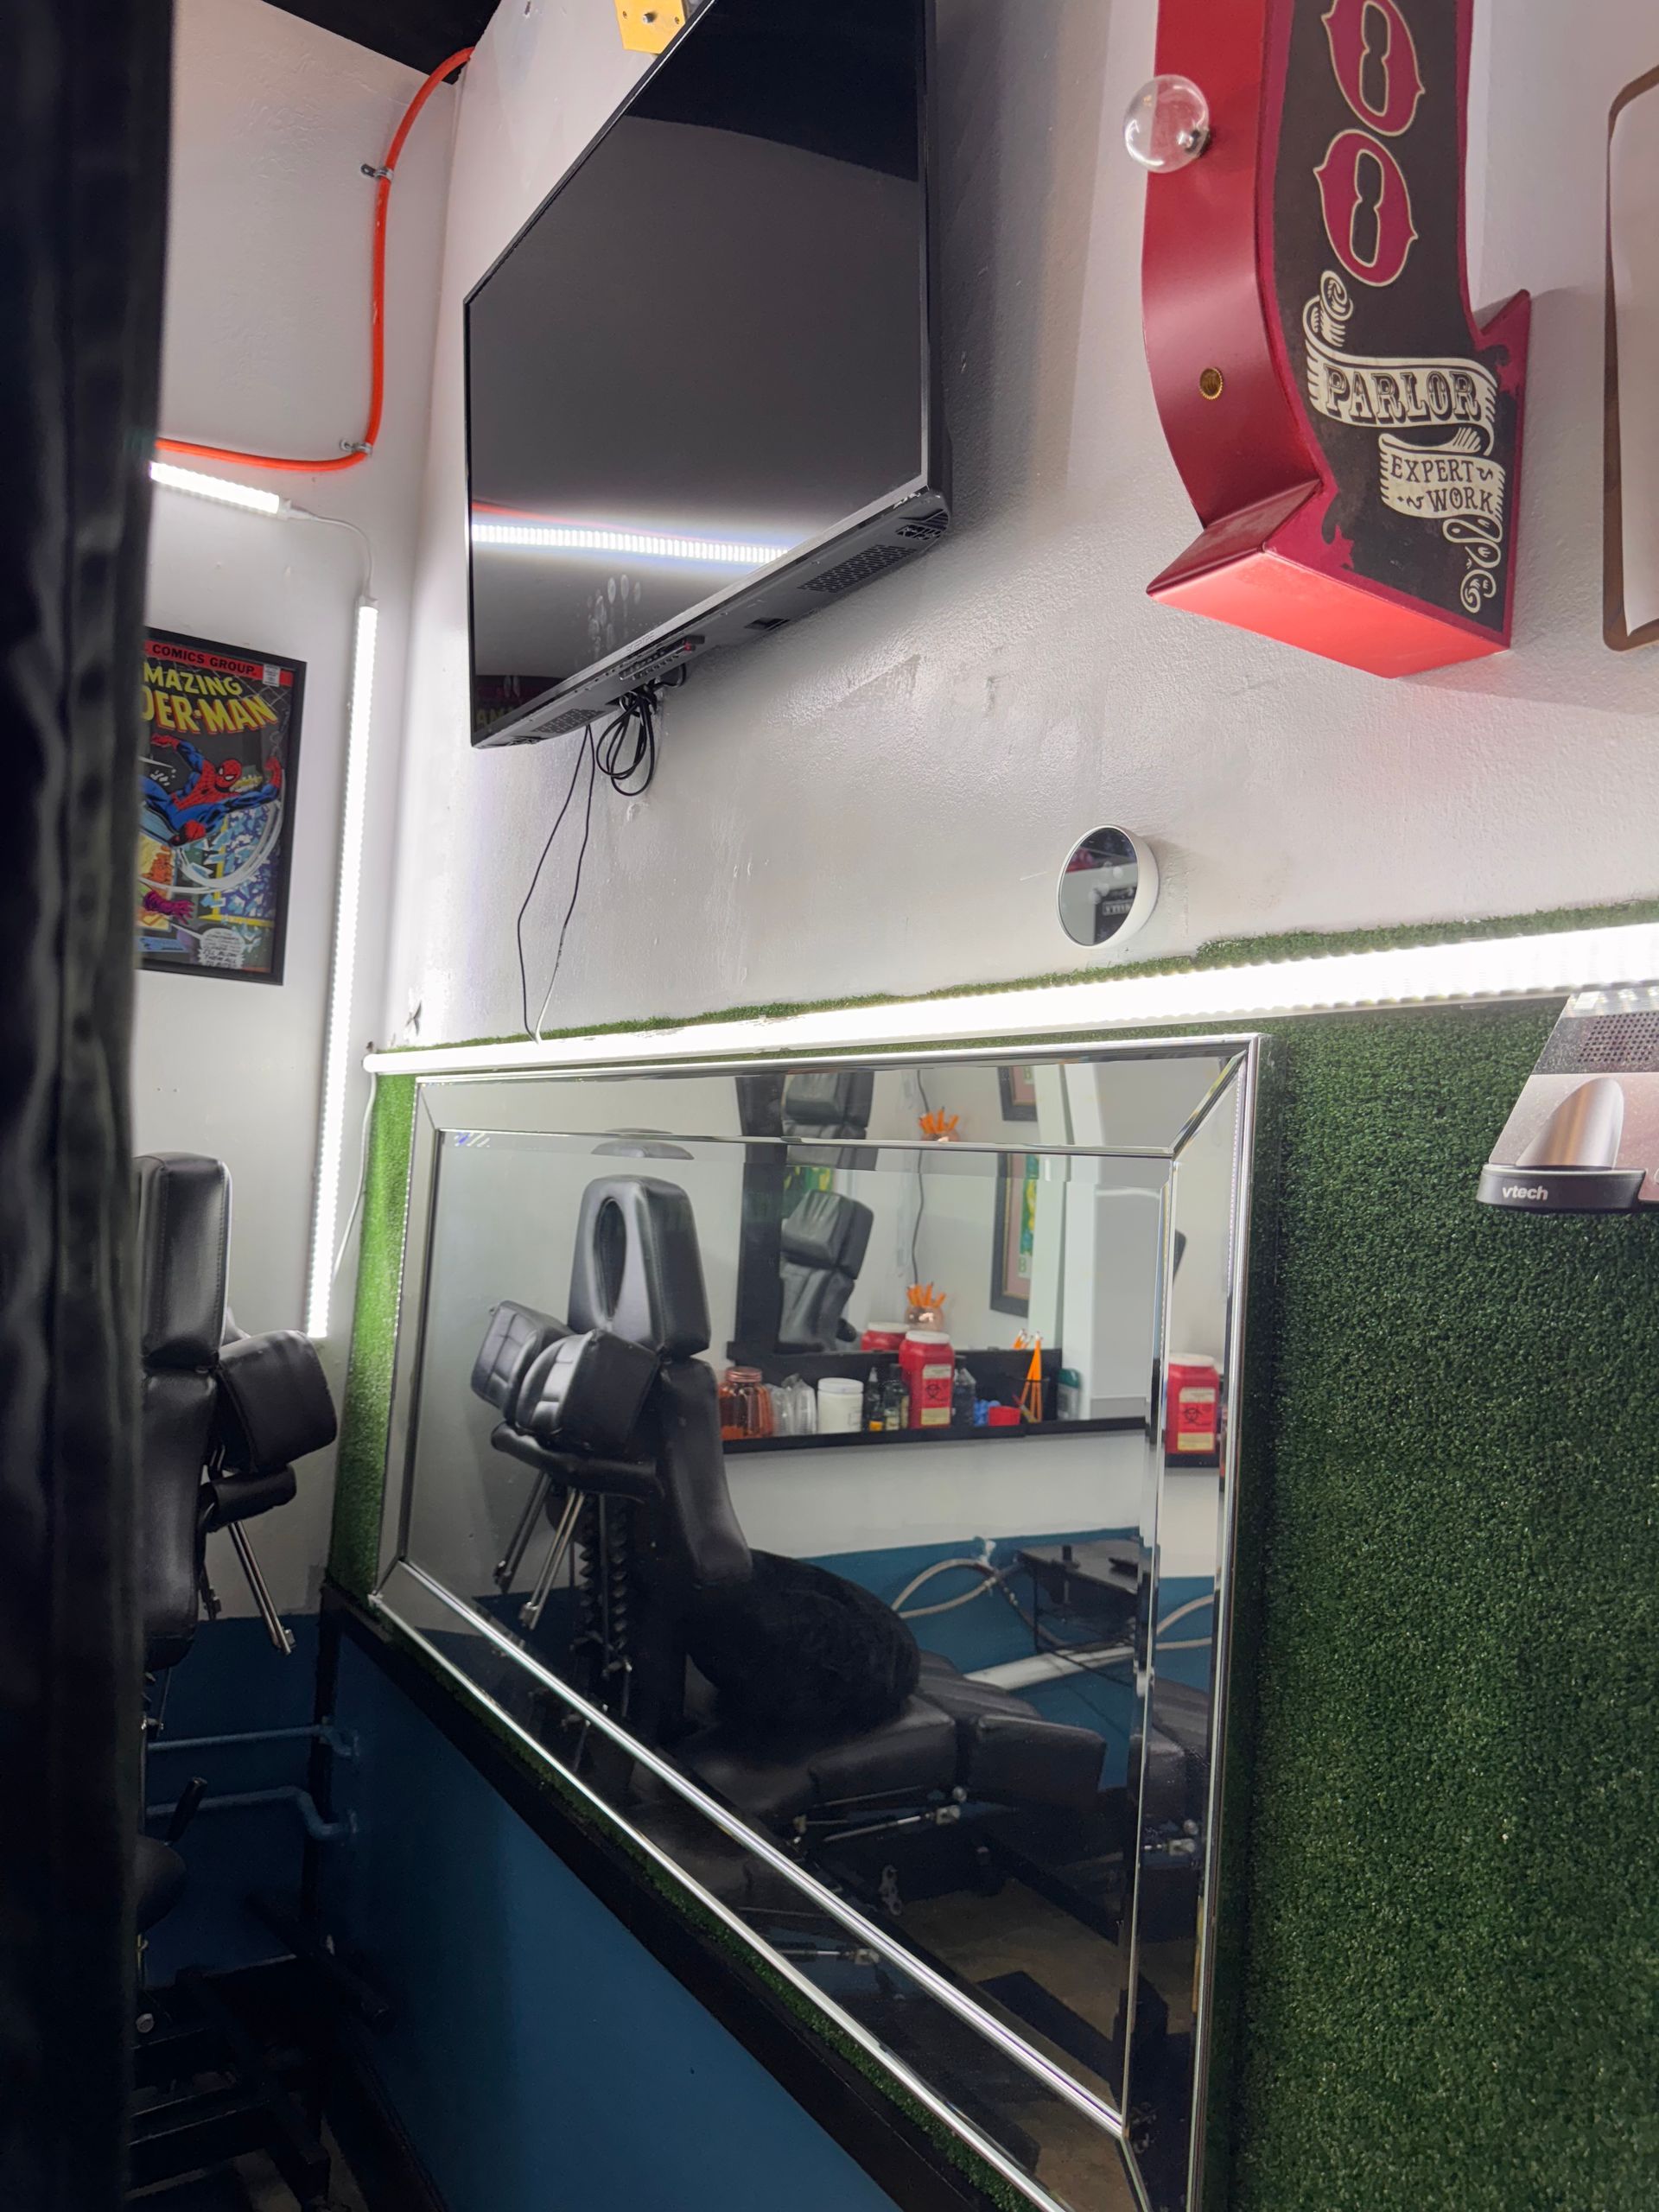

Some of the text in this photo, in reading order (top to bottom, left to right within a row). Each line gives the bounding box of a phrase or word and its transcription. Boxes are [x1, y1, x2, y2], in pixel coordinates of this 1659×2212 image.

[1323, 363, 1482, 425] PARLOR
[1390, 454, 1474, 483] EXPERT
[1426, 486, 1494, 514] WORK
[152, 644, 205, 664] COMICS
[143, 662, 243, 696] MAZING
[141, 685, 278, 734] DER-MAN
[1502, 1185, 1548, 1201] vtech
